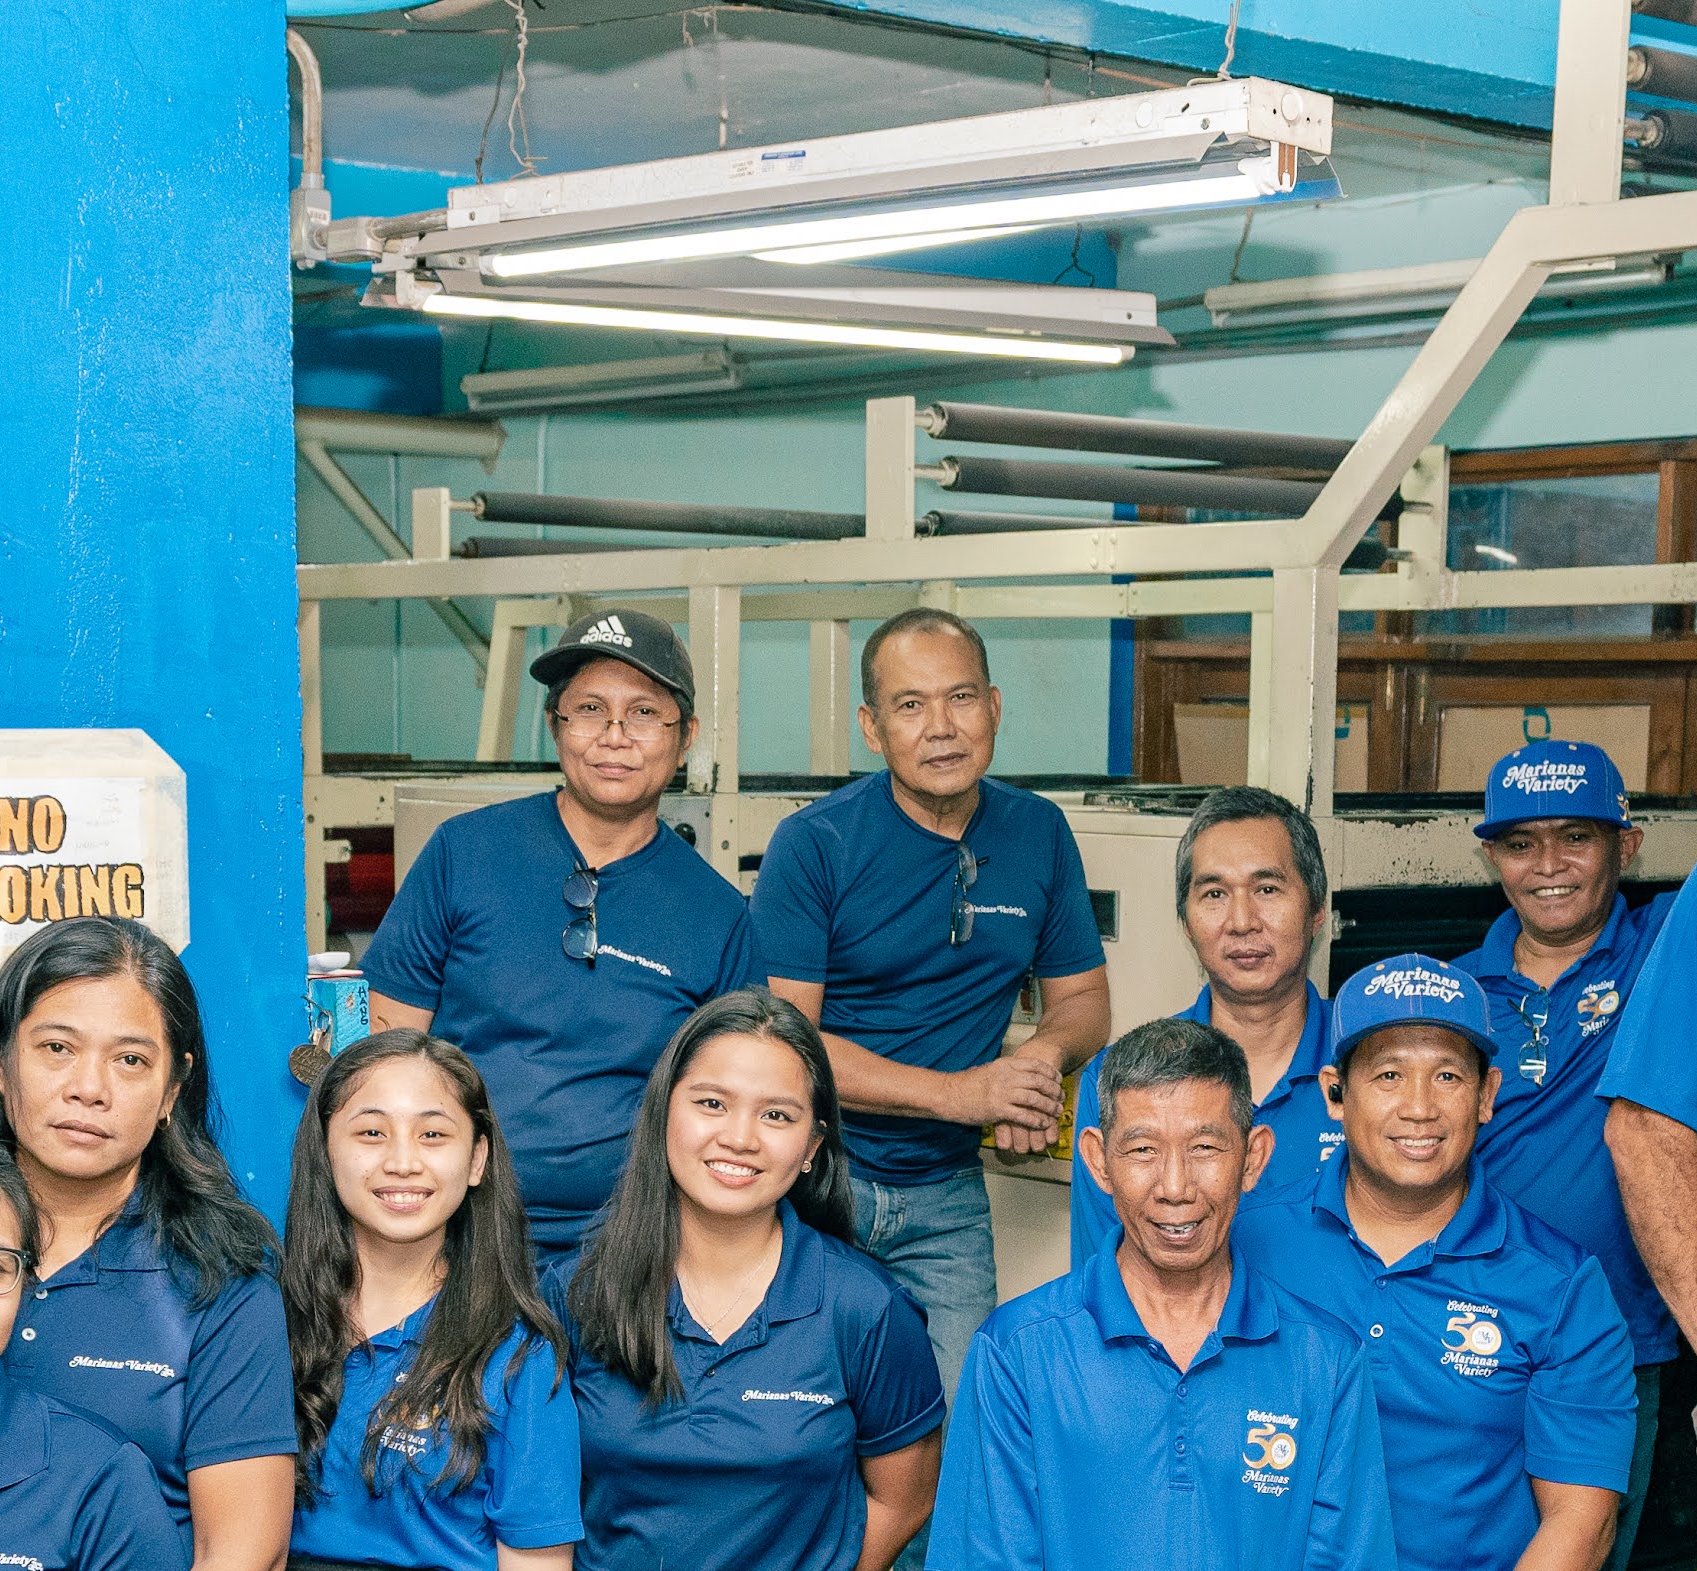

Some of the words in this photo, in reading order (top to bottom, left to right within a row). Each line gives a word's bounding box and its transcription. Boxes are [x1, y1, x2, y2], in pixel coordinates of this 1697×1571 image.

[580, 631, 633, 648] adidas
[1502, 760, 1586, 788] Marianas
[1517, 776, 1588, 795] Variety
[1364, 967, 1460, 996] Marianas
[1384, 980, 1465, 1003] Variety
[1446, 1300, 1498, 1318] Celebrating
[1441, 1312, 1502, 1356] 50
[69, 1356, 124, 1369] Marianas
[125, 1360, 168, 1374] Variety
[1440, 1351, 1498, 1367] Marianas
[1454, 1364, 1498, 1377] Variety
[742, 1390, 790, 1401] Marianas
[790, 1391, 829, 1404] Variety
[1247, 1409, 1299, 1429] Celebrating
[1243, 1423, 1297, 1470] 50
[1242, 1470, 1289, 1484] Marianas
[1253, 1482, 1290, 1497] Variety
